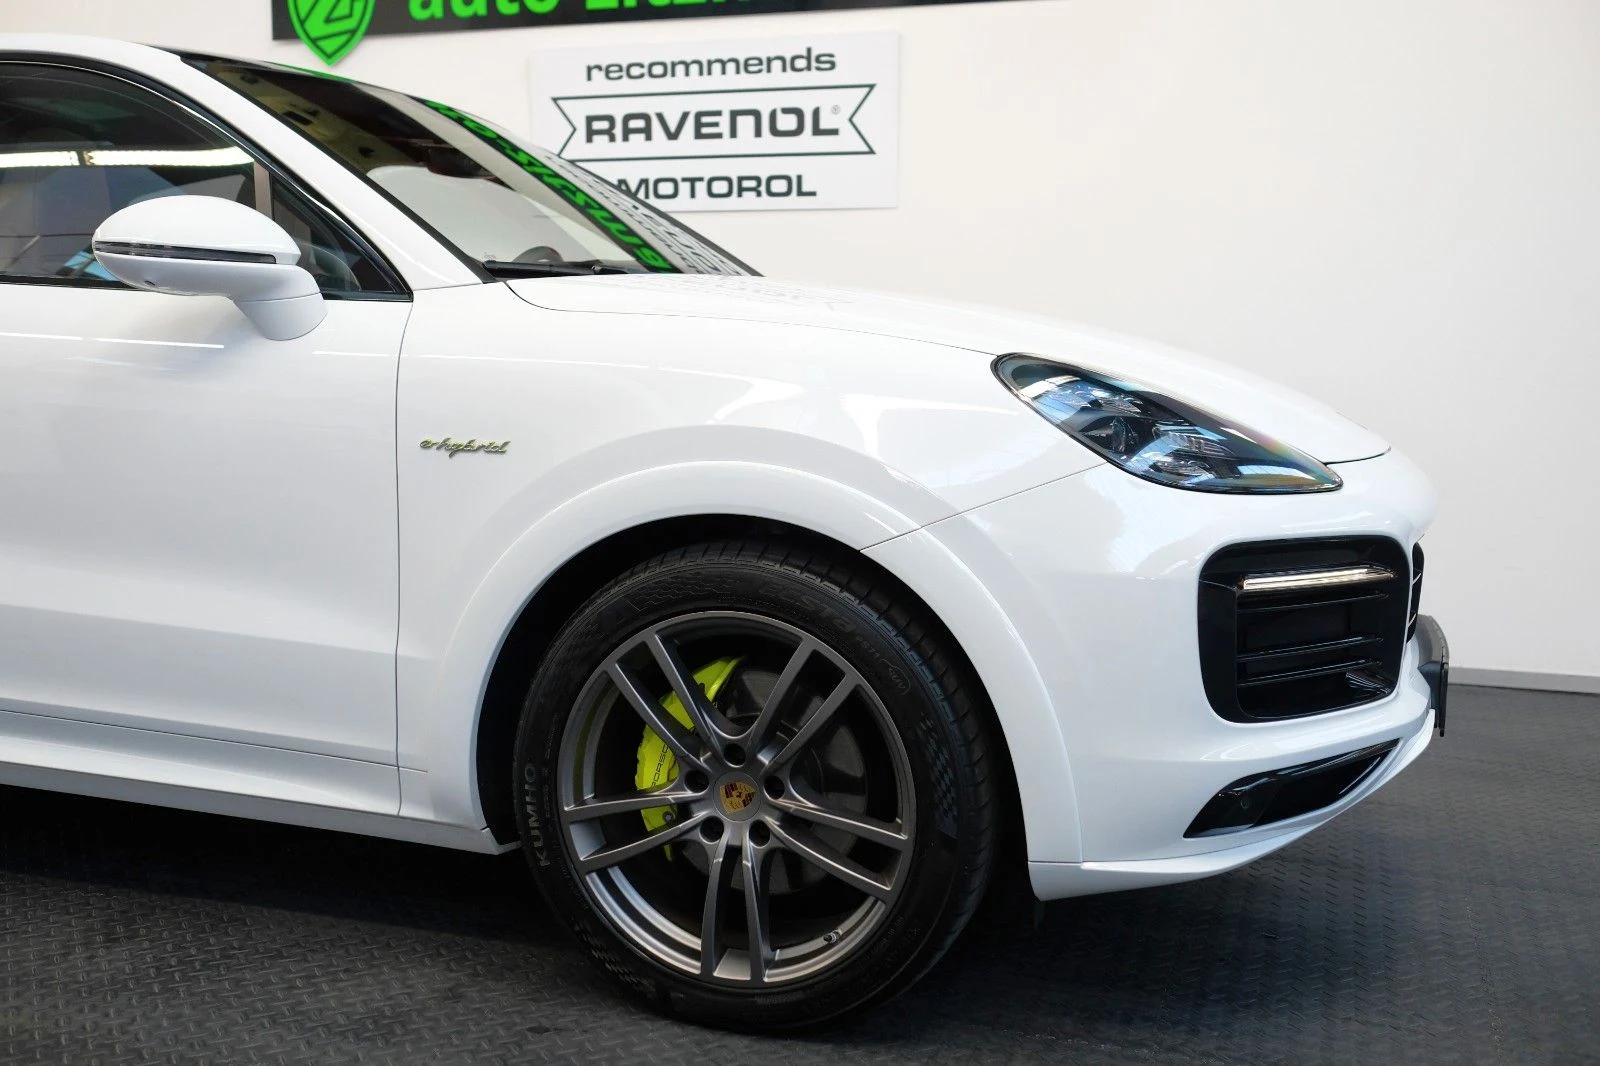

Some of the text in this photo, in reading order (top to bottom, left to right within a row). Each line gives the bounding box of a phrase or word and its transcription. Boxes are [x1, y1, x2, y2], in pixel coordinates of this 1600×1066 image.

[586, 47, 836, 81] recommends
[585, 106, 840, 143] RAVENOL
[617, 174, 817, 199] MOTOROL
[652, 743, 669, 788] PORSC
[524, 763, 551, 868] KUMHO
